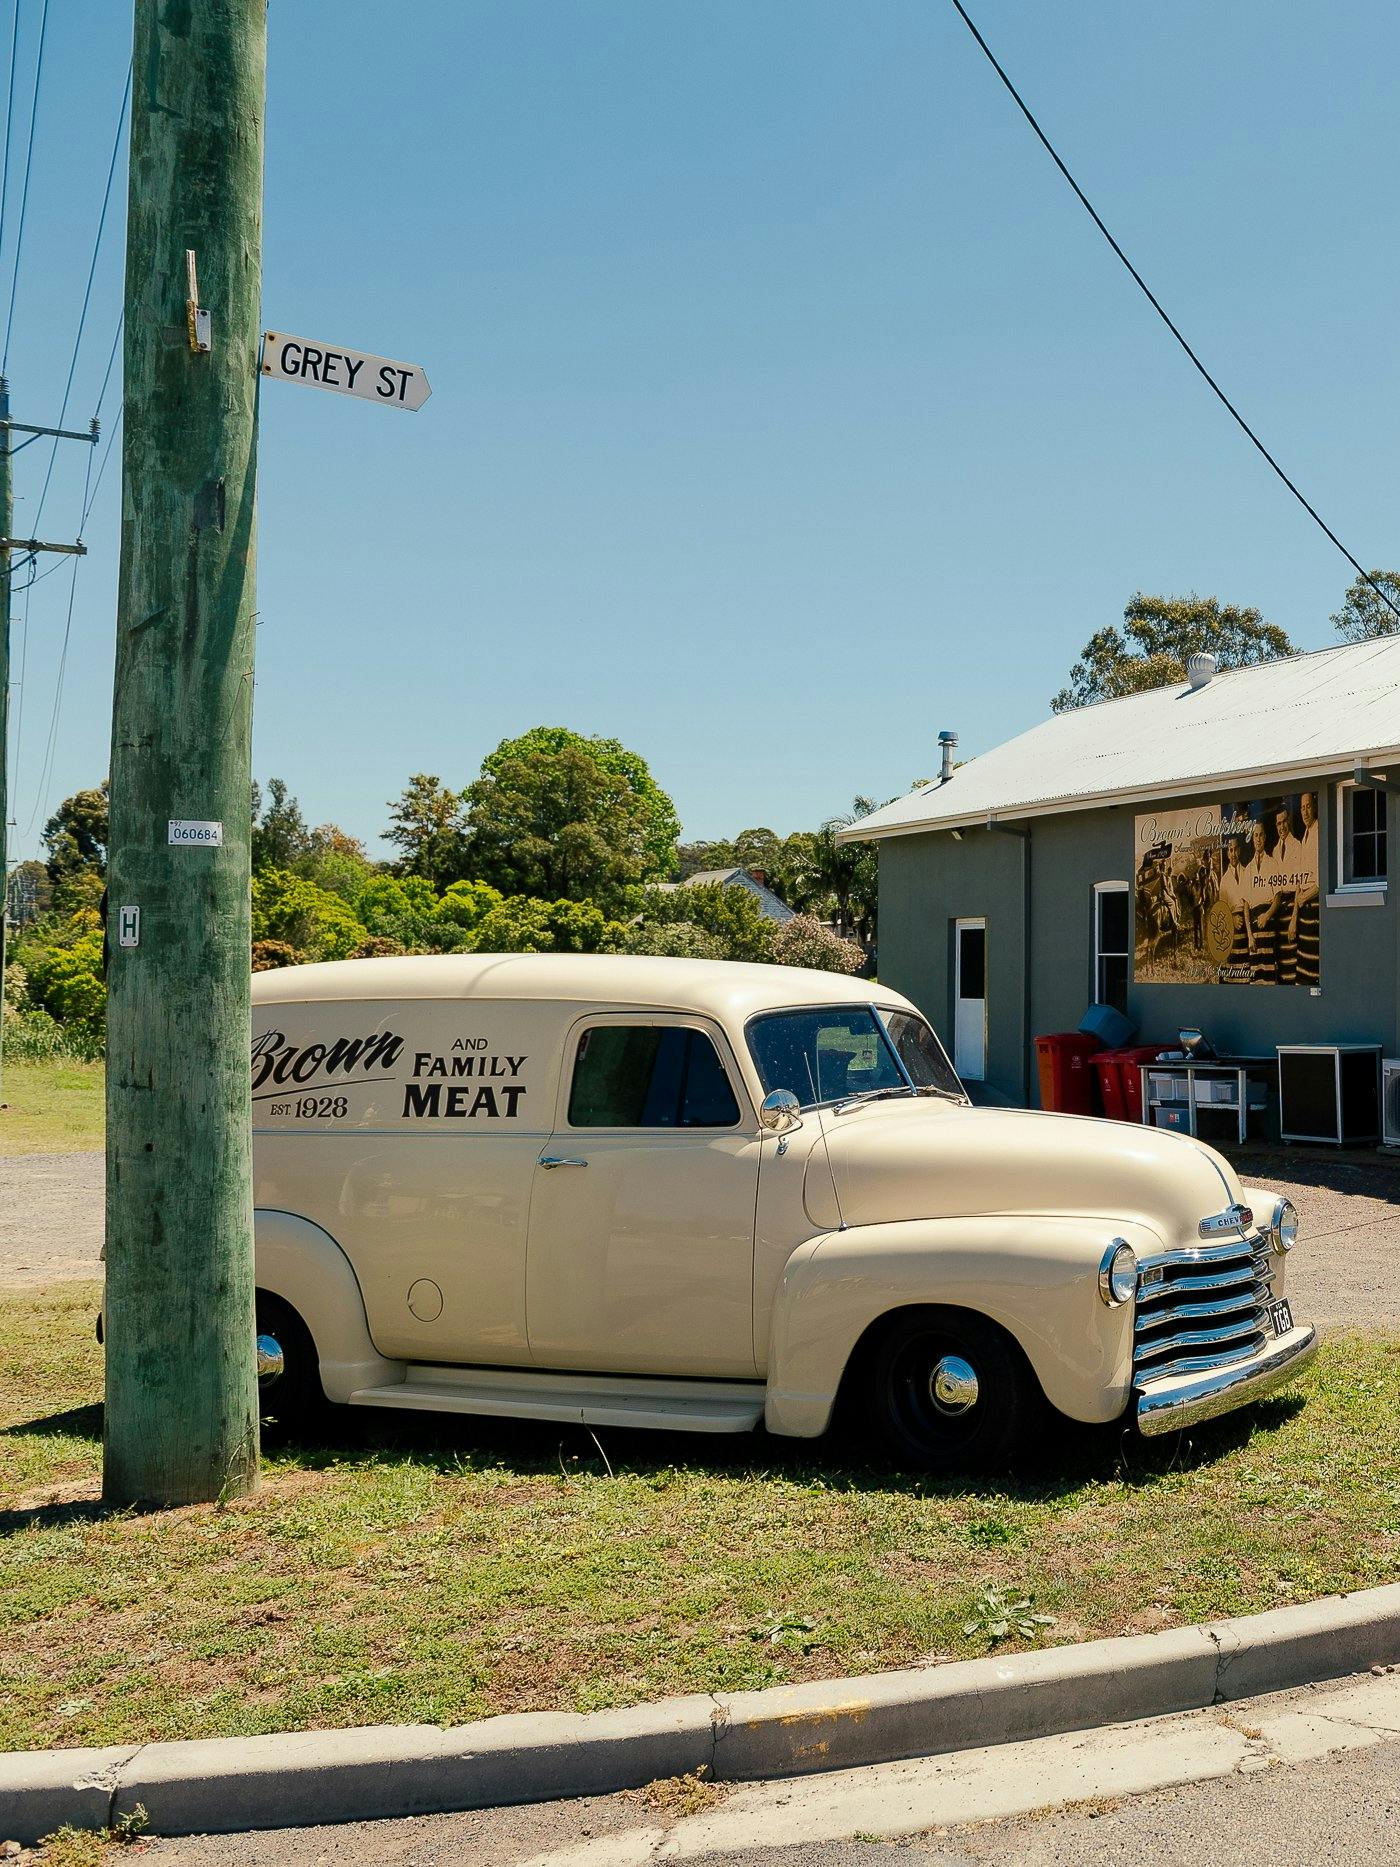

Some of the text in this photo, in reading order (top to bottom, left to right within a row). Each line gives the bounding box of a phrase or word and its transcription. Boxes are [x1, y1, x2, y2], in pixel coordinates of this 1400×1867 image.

[281, 343, 413, 401] GREY ST
[174, 828, 218, 840] 060684
[1141, 811, 1257, 844] Brown's Butchery
[1253, 872, 1310, 888] Ph: 4996 4117
[123, 913, 137, 937] H
[451, 1038, 488, 1051] AND
[251, 1029, 405, 1091] Brown
[412, 1053, 528, 1077] FAMILY
[270, 1097, 348, 1119] EST. 1928
[401, 1083, 527, 1118] MEAT
